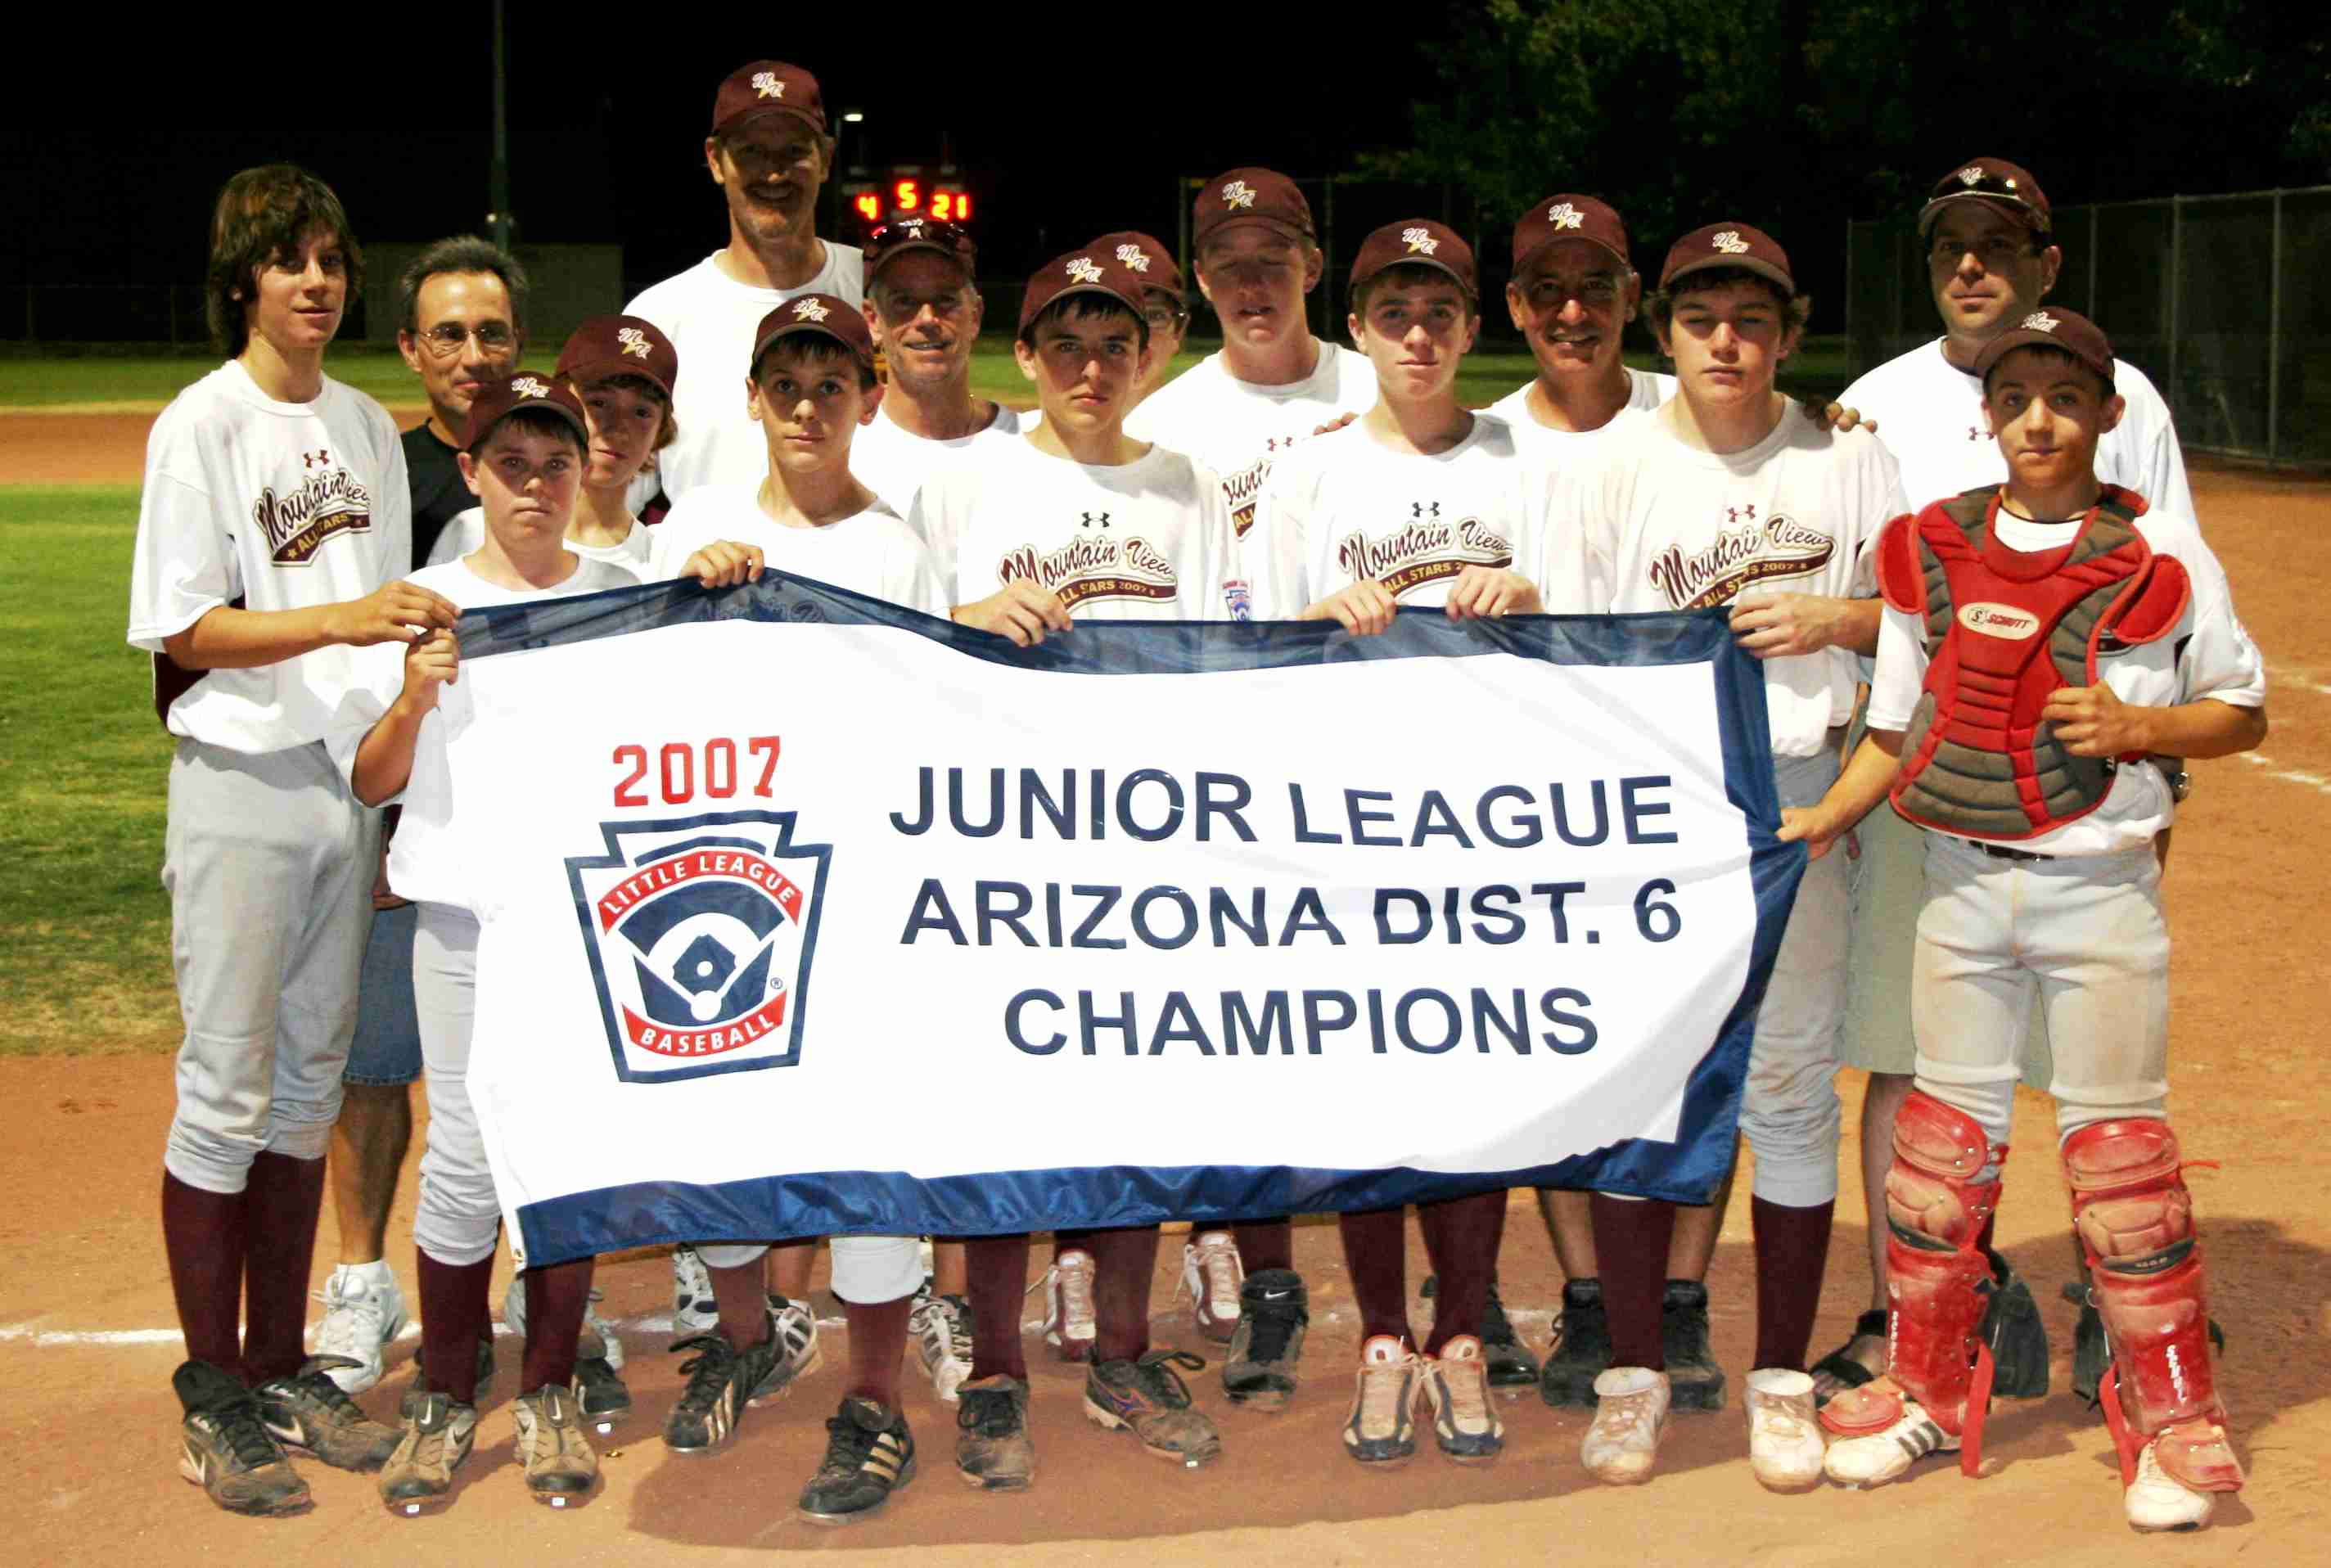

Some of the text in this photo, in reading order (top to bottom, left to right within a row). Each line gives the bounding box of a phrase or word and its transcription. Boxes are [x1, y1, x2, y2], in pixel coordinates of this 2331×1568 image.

[858, 195, 879, 221] 4
[897, 182, 918, 210] 5
[930, 193, 968, 220] 21
[1339, 520, 1507, 581] Mountain View
[1768, 517, 1825, 546] View
[1000, 539, 1173, 585] Mountain View
[1409, 562, 1451, 581] STARS
[614, 736, 781, 807] 2007
[890, 766, 1679, 849] JUNIOR LEAGUE
[604, 854, 796, 914] LITTLE LEAGUE
[899, 877, 1682, 950] ARIZONA DIST. 6
[640, 1013, 775, 1053] BASEBALL
[1004, 987, 1598, 1056] CHAMPIONS
